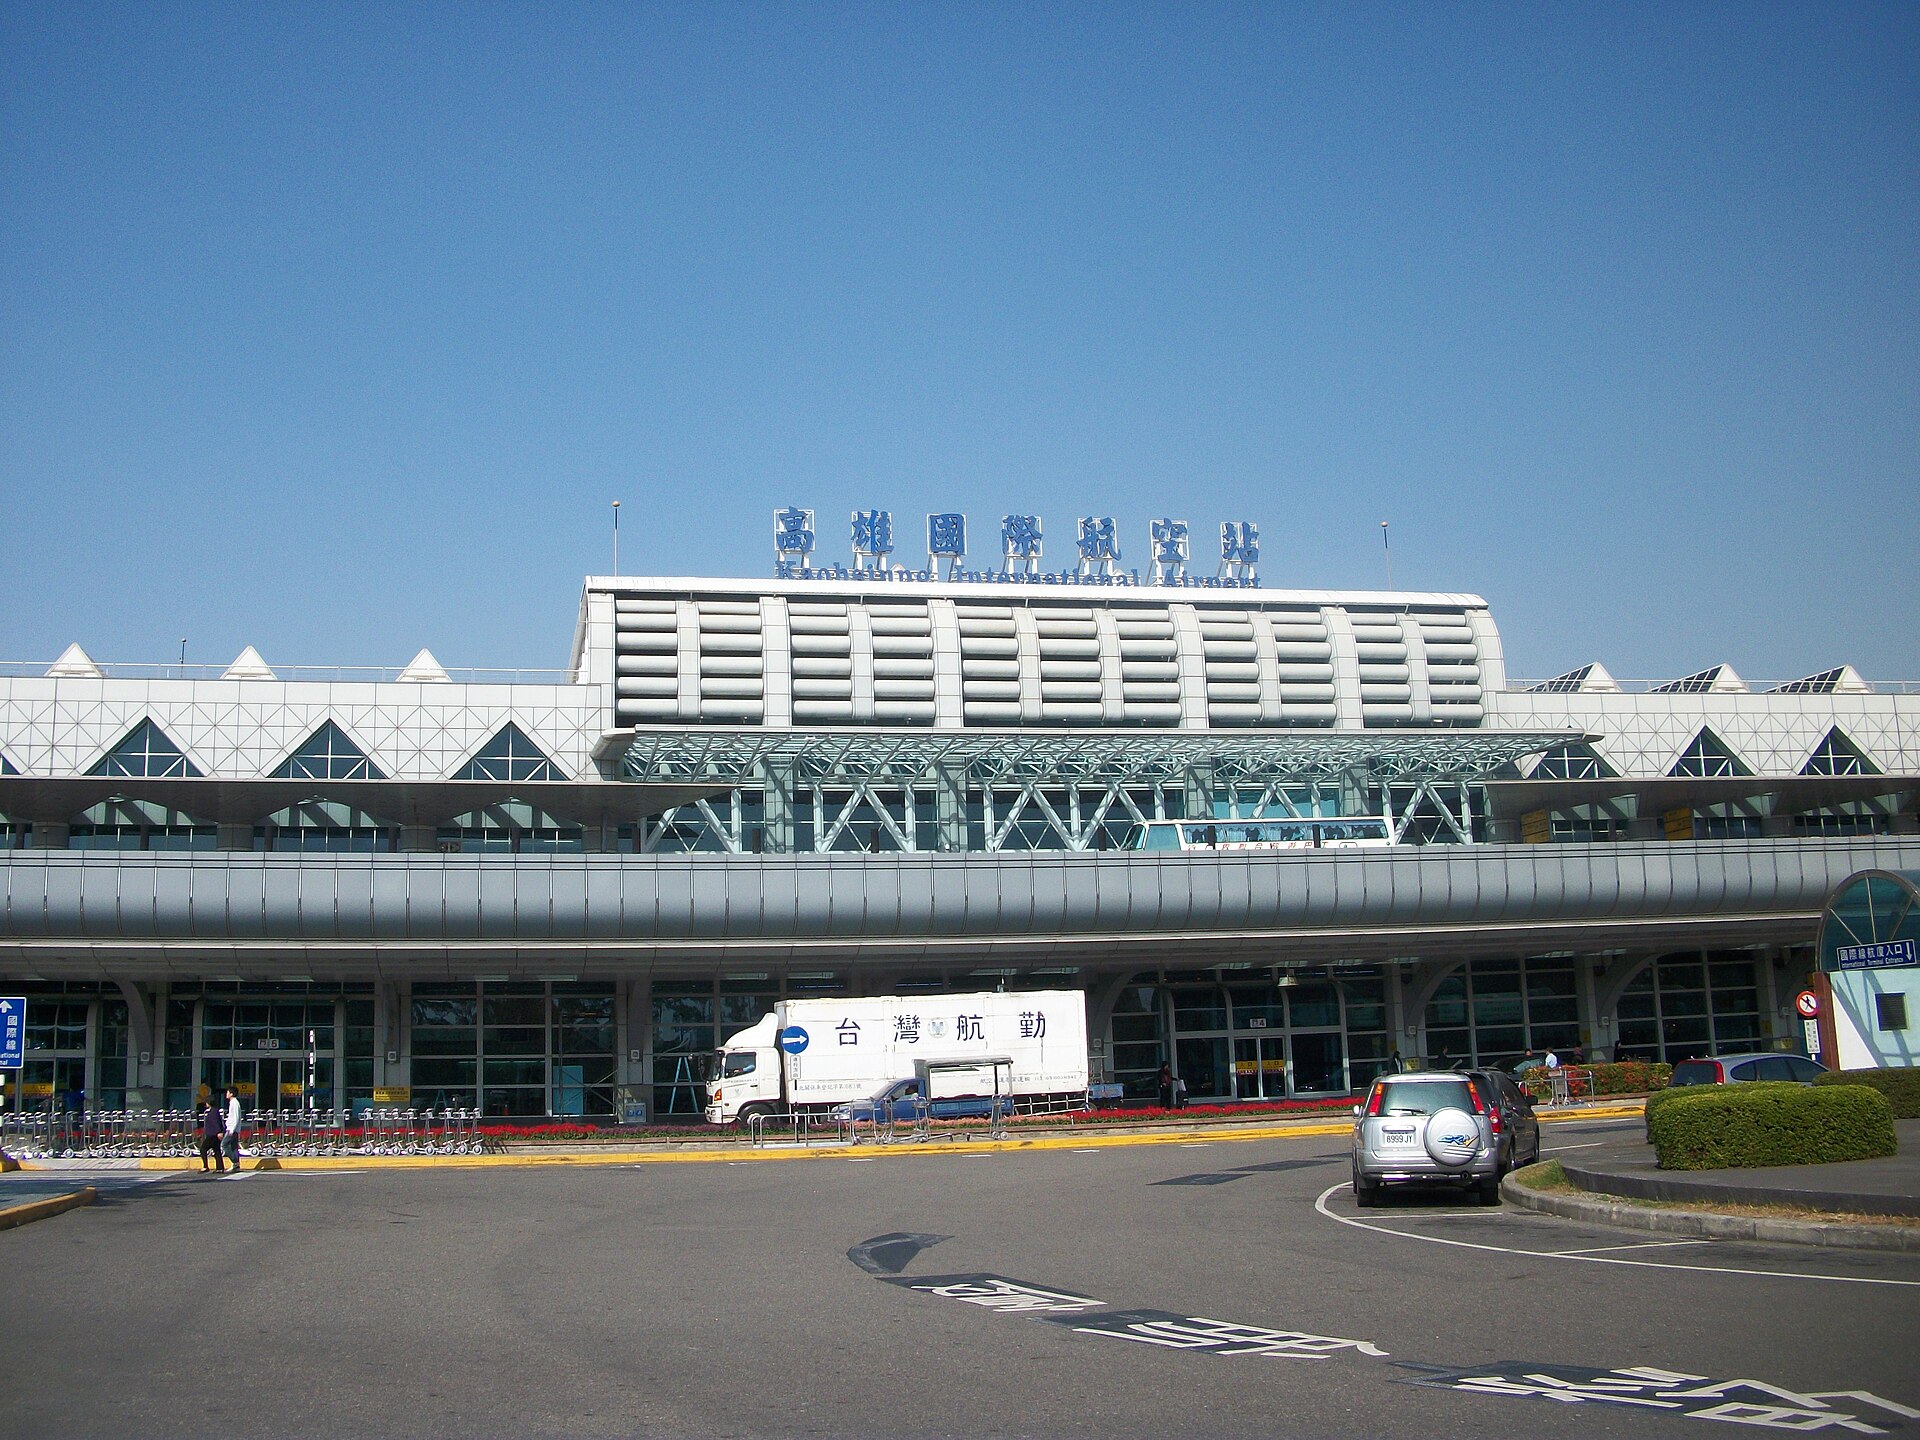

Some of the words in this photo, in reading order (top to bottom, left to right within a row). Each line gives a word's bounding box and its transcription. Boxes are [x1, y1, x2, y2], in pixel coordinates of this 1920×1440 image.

[776, 506, 1259, 562] 高雄國際航空站
[953, 565, 1141, 587] International
[6, 1015, 18, 1051] 國際線
[835, 1011, 1046, 1046] 台灣航勤
